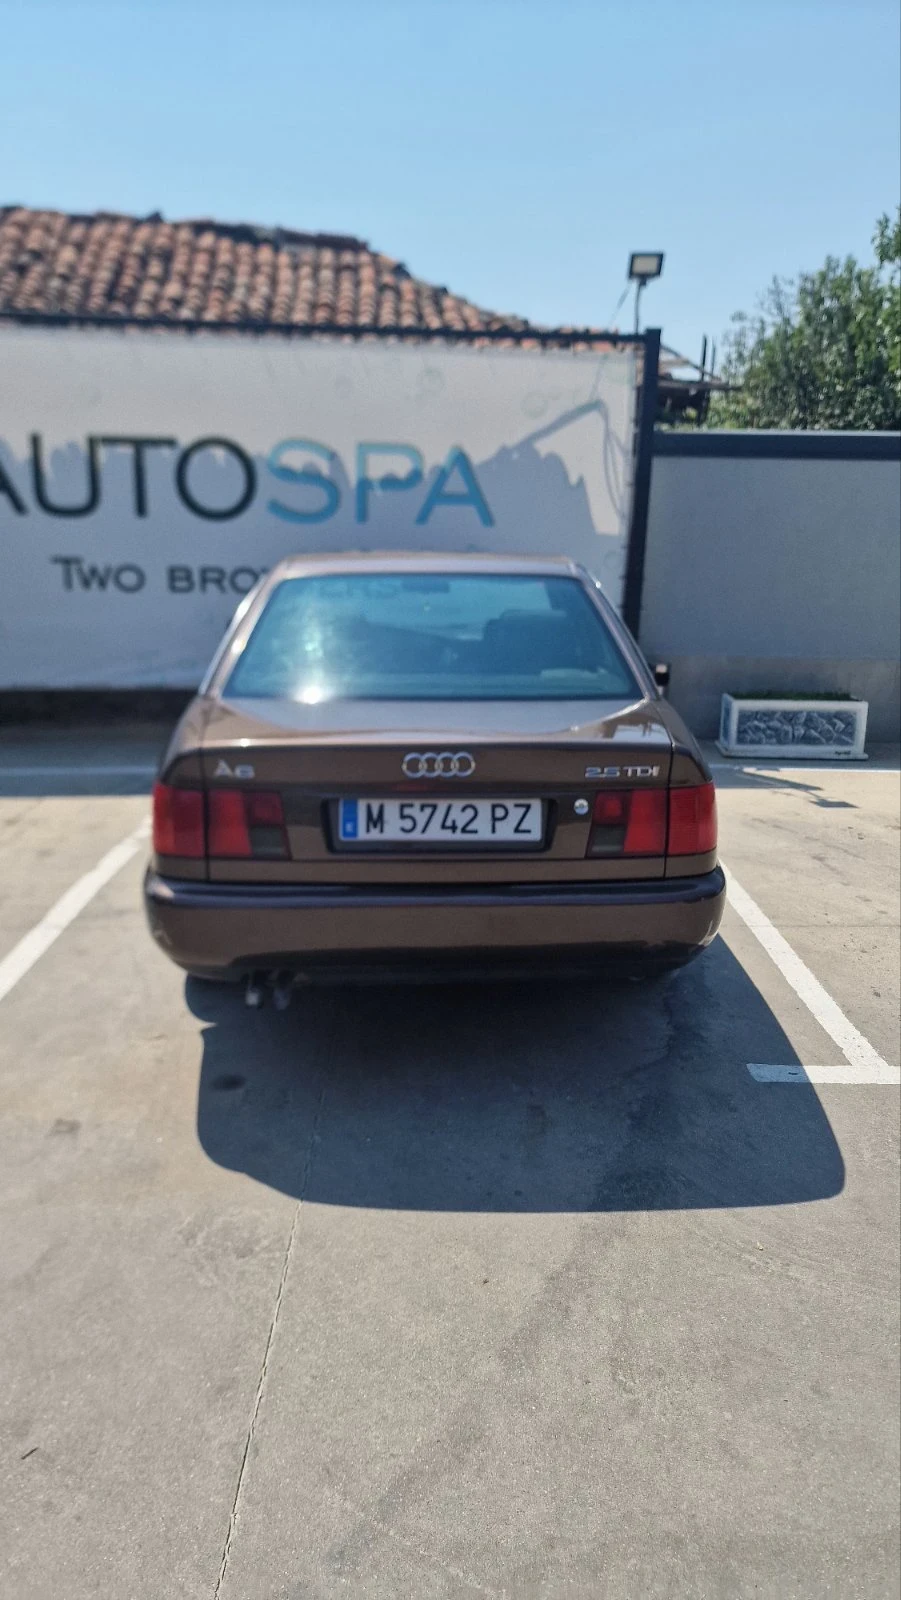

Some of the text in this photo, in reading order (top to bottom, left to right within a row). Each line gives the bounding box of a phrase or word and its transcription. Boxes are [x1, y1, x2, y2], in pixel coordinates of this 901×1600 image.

[214, 759, 255, 779] A6
[623, 765, 661, 777] TDI
[365, 802, 532, 835] M 5742 PZ
